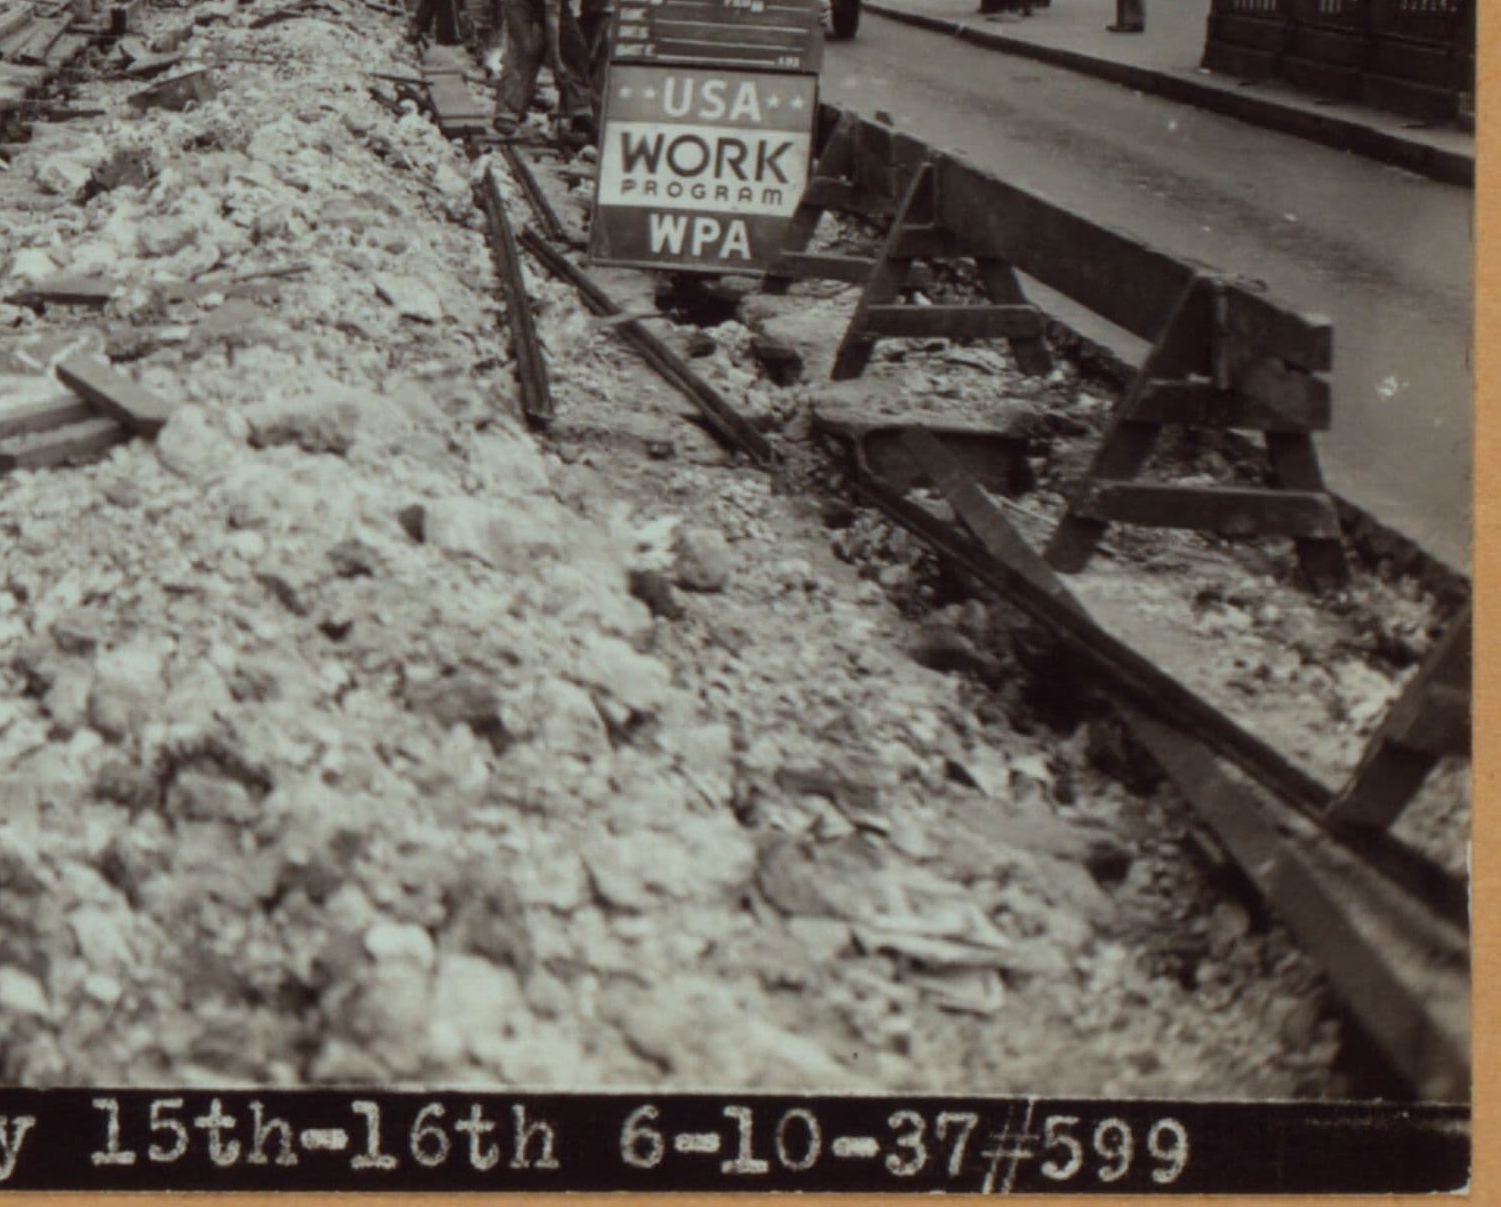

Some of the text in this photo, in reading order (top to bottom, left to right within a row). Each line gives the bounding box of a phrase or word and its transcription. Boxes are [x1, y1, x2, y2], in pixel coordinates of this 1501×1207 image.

[662, 76, 762, 122] USA
[620, 132, 794, 184] WORK
[620, 179, 784, 206] PROGRAM
[650, 213, 752, 260] WPA
